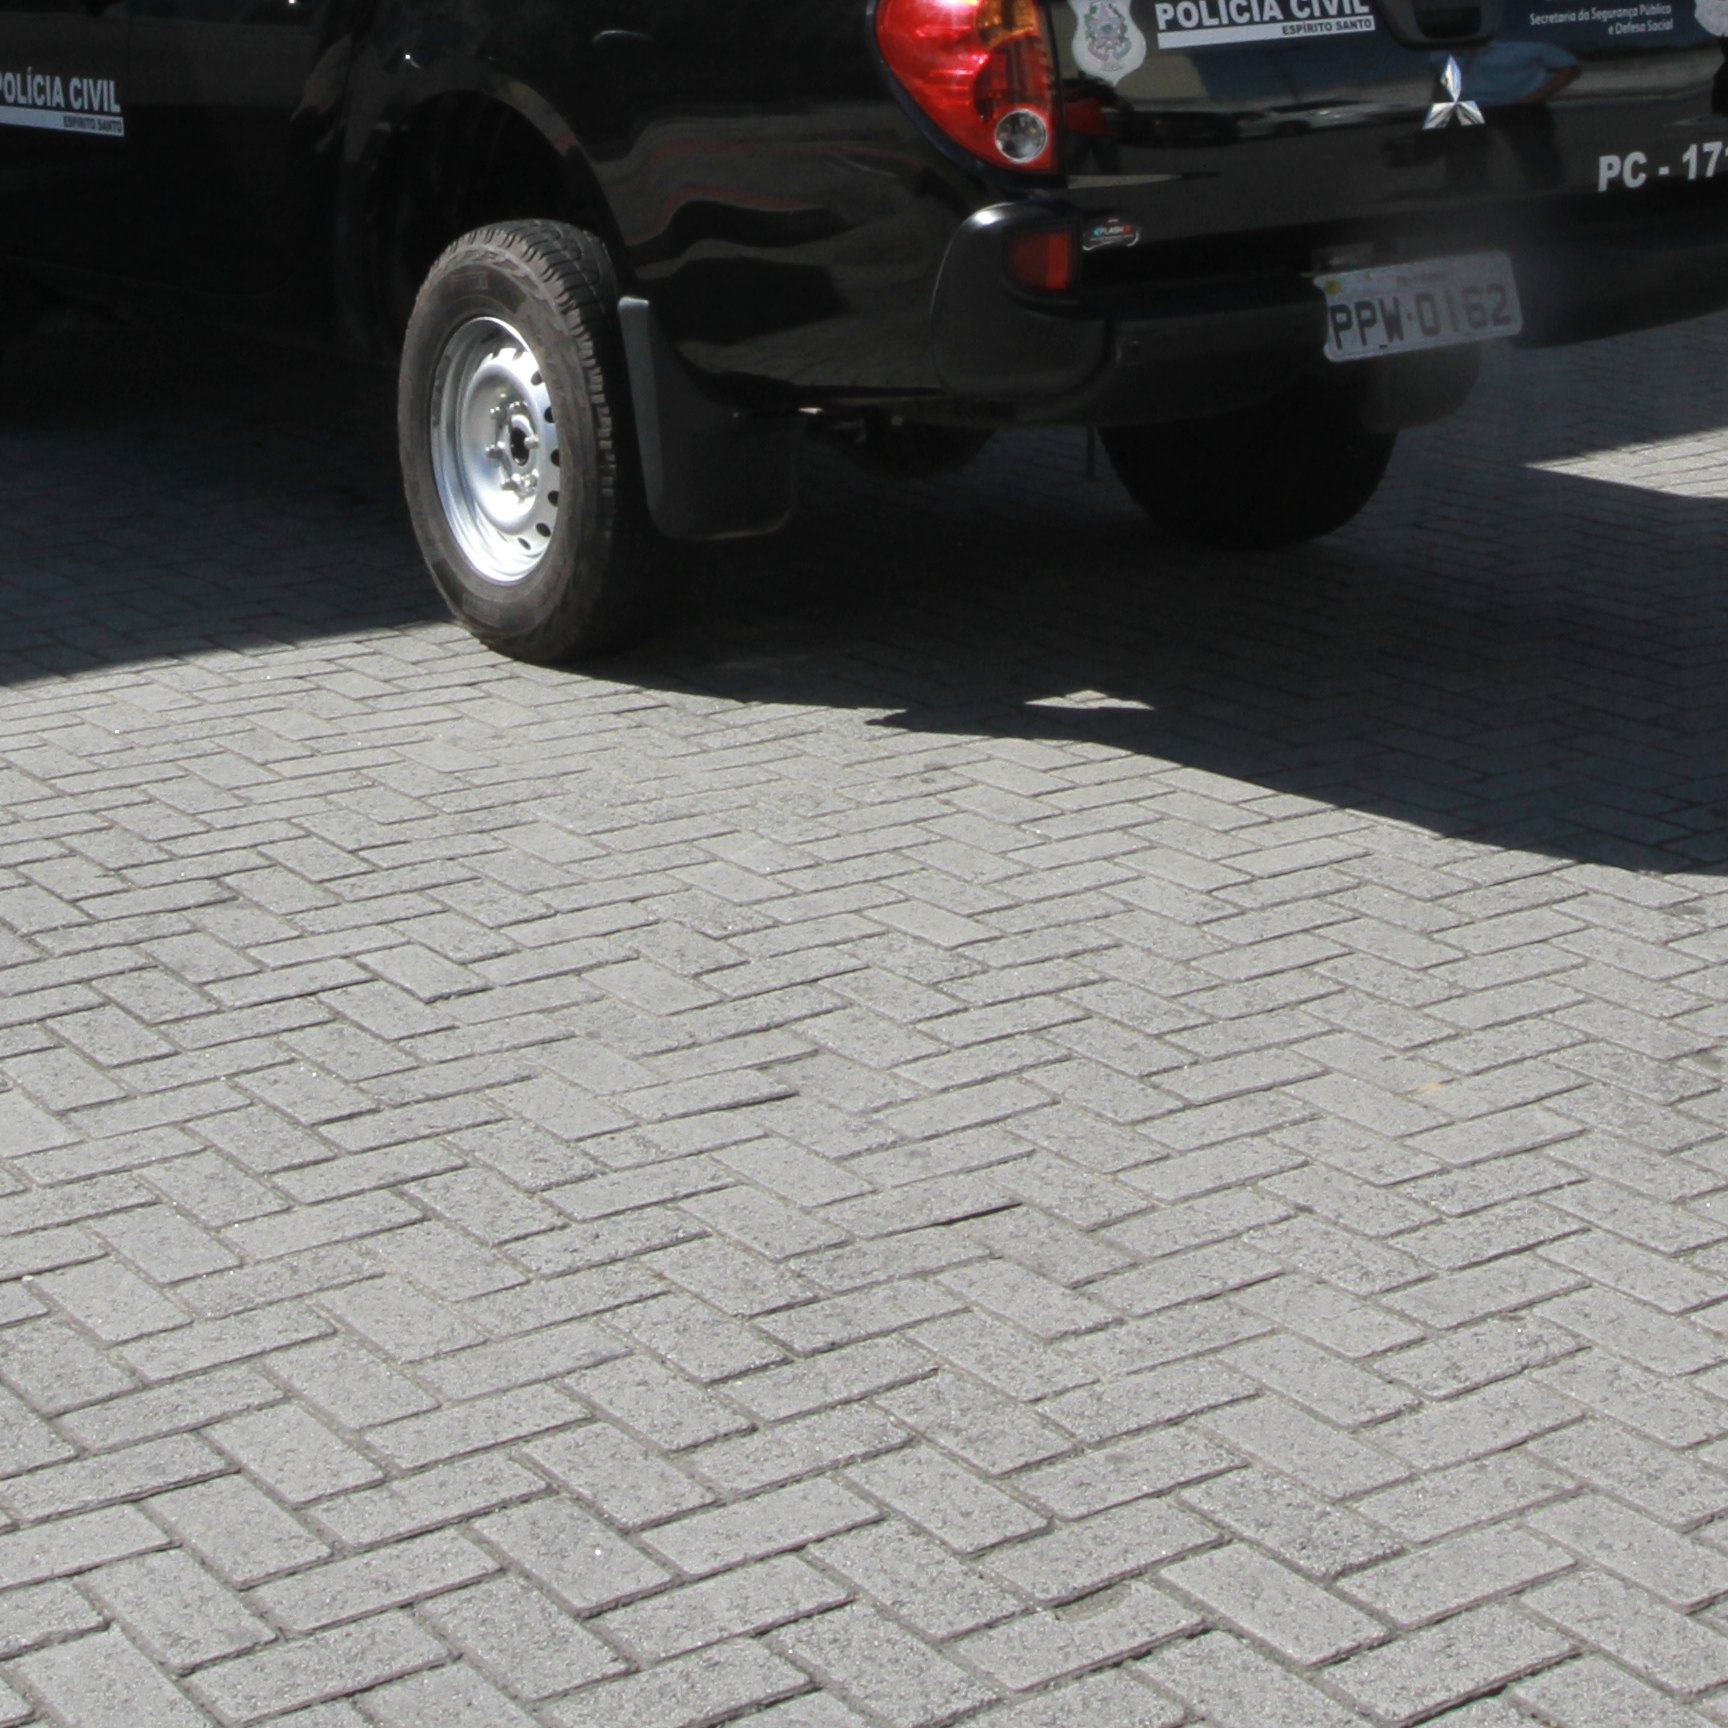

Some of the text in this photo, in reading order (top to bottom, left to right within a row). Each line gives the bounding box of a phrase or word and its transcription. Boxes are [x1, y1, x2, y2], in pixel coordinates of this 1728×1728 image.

[1282, 18, 1372, 36] ESPÍRITO SANTO
[69, 77, 121, 113] CIVIL
[1597, 151, 1648, 192] PC
